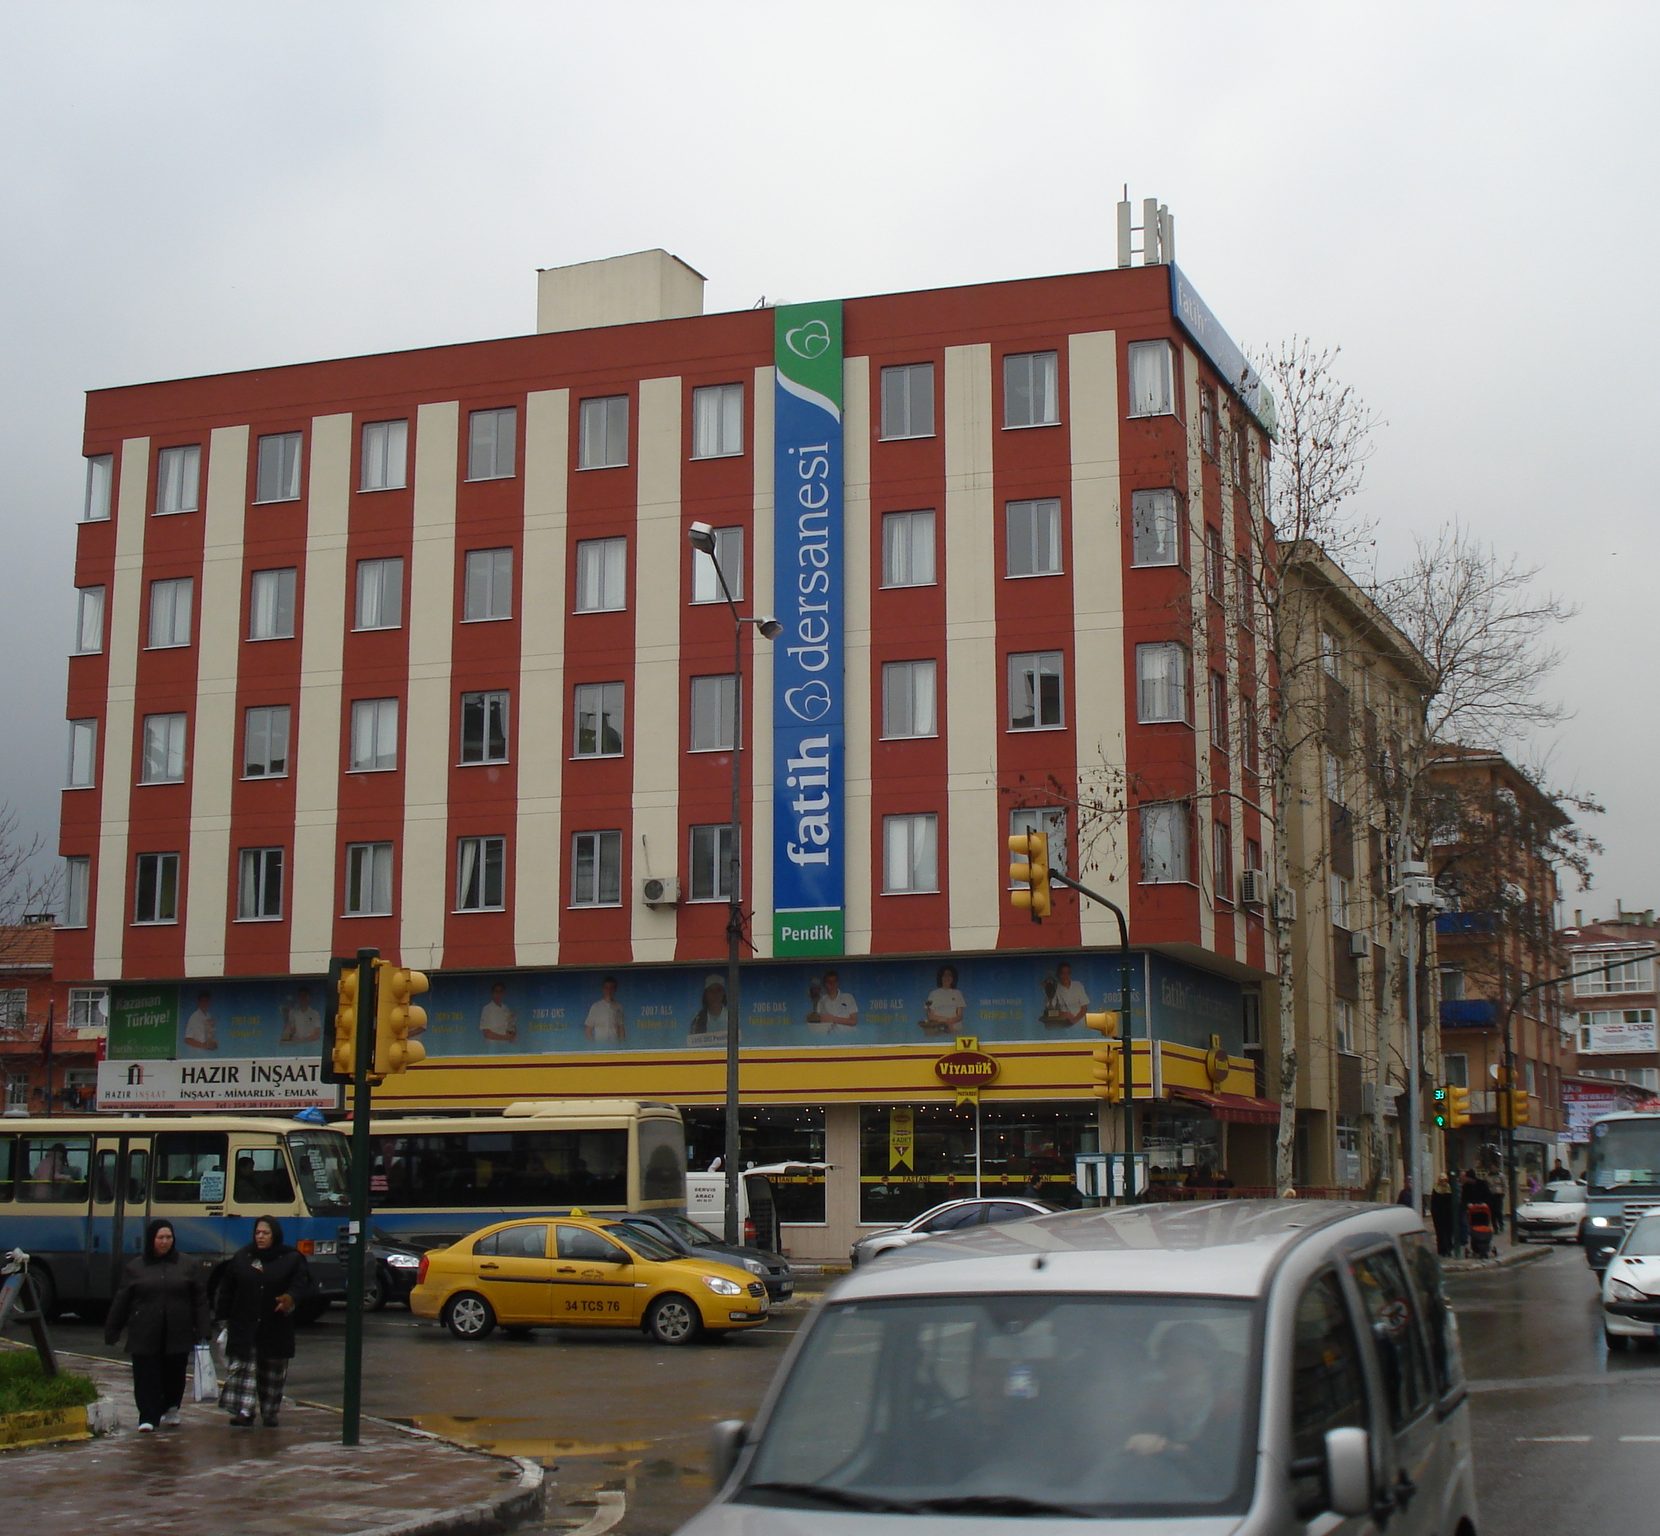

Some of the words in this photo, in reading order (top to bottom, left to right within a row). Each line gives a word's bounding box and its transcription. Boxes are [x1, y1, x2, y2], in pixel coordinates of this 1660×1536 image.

[1178, 282, 1205, 334] fatih
[787, 441, 829, 672] dersanesi
[787, 733, 829, 866] fatih
[781, 925, 833, 942] Pendik
[115, 995, 161, 1010] Kazanan
[125, 1009, 171, 1028] Türkiye!
[960, 1039, 974, 1048] V
[181, 1065, 239, 1084] HAZIR
[250, 1061, 321, 1087] İNŞAAT
[105, 1090, 131, 1099] HAZIR
[179, 1089, 215, 1100] İNŞAAT
[224, 1088, 275, 1099] MİMARLIK
[284, 1088, 319, 1098] EMLAK
[902, 1175, 931, 1183] PASTANE
[565, 1300, 578, 1312] 34
[580, 1300, 604, 1312] TCS
[607, 1300, 620, 1312] 76
